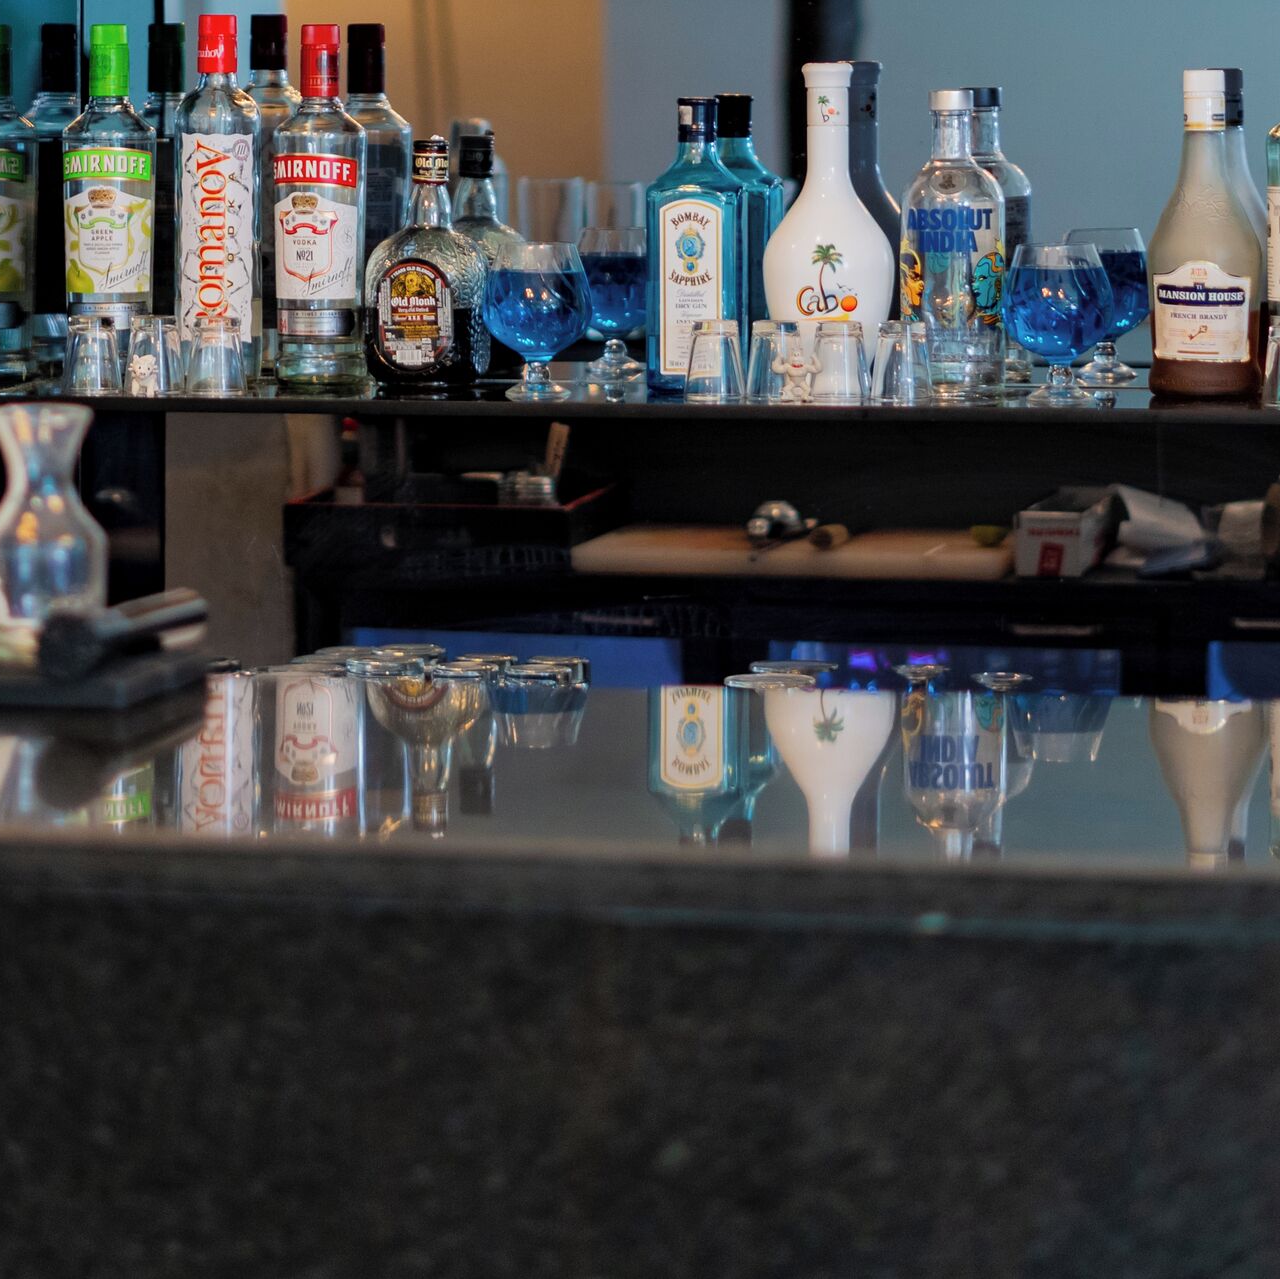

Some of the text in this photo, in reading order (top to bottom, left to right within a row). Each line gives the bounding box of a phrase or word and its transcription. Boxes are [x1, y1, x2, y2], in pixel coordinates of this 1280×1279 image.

[64, 154, 147, 175] SMIRNOFF
[273, 159, 351, 182] SMIRNOFF
[415, 157, 432, 168] Old
[226, 172, 236, 289] VODKA
[670, 212, 711, 230] BOMBAY
[908, 208, 993, 231] ABSOLUT
[918, 231, 978, 253] INDIA
[98, 250, 149, 290] Smirnoff
[302, 256, 354, 297] Smirnoff
[669, 270, 712, 286] SAPPHIRE
[391, 296, 436, 308] Old Monk
[796, 280, 859, 315] Cabo
[1159, 288, 1245, 301] MANSION HOUSE
